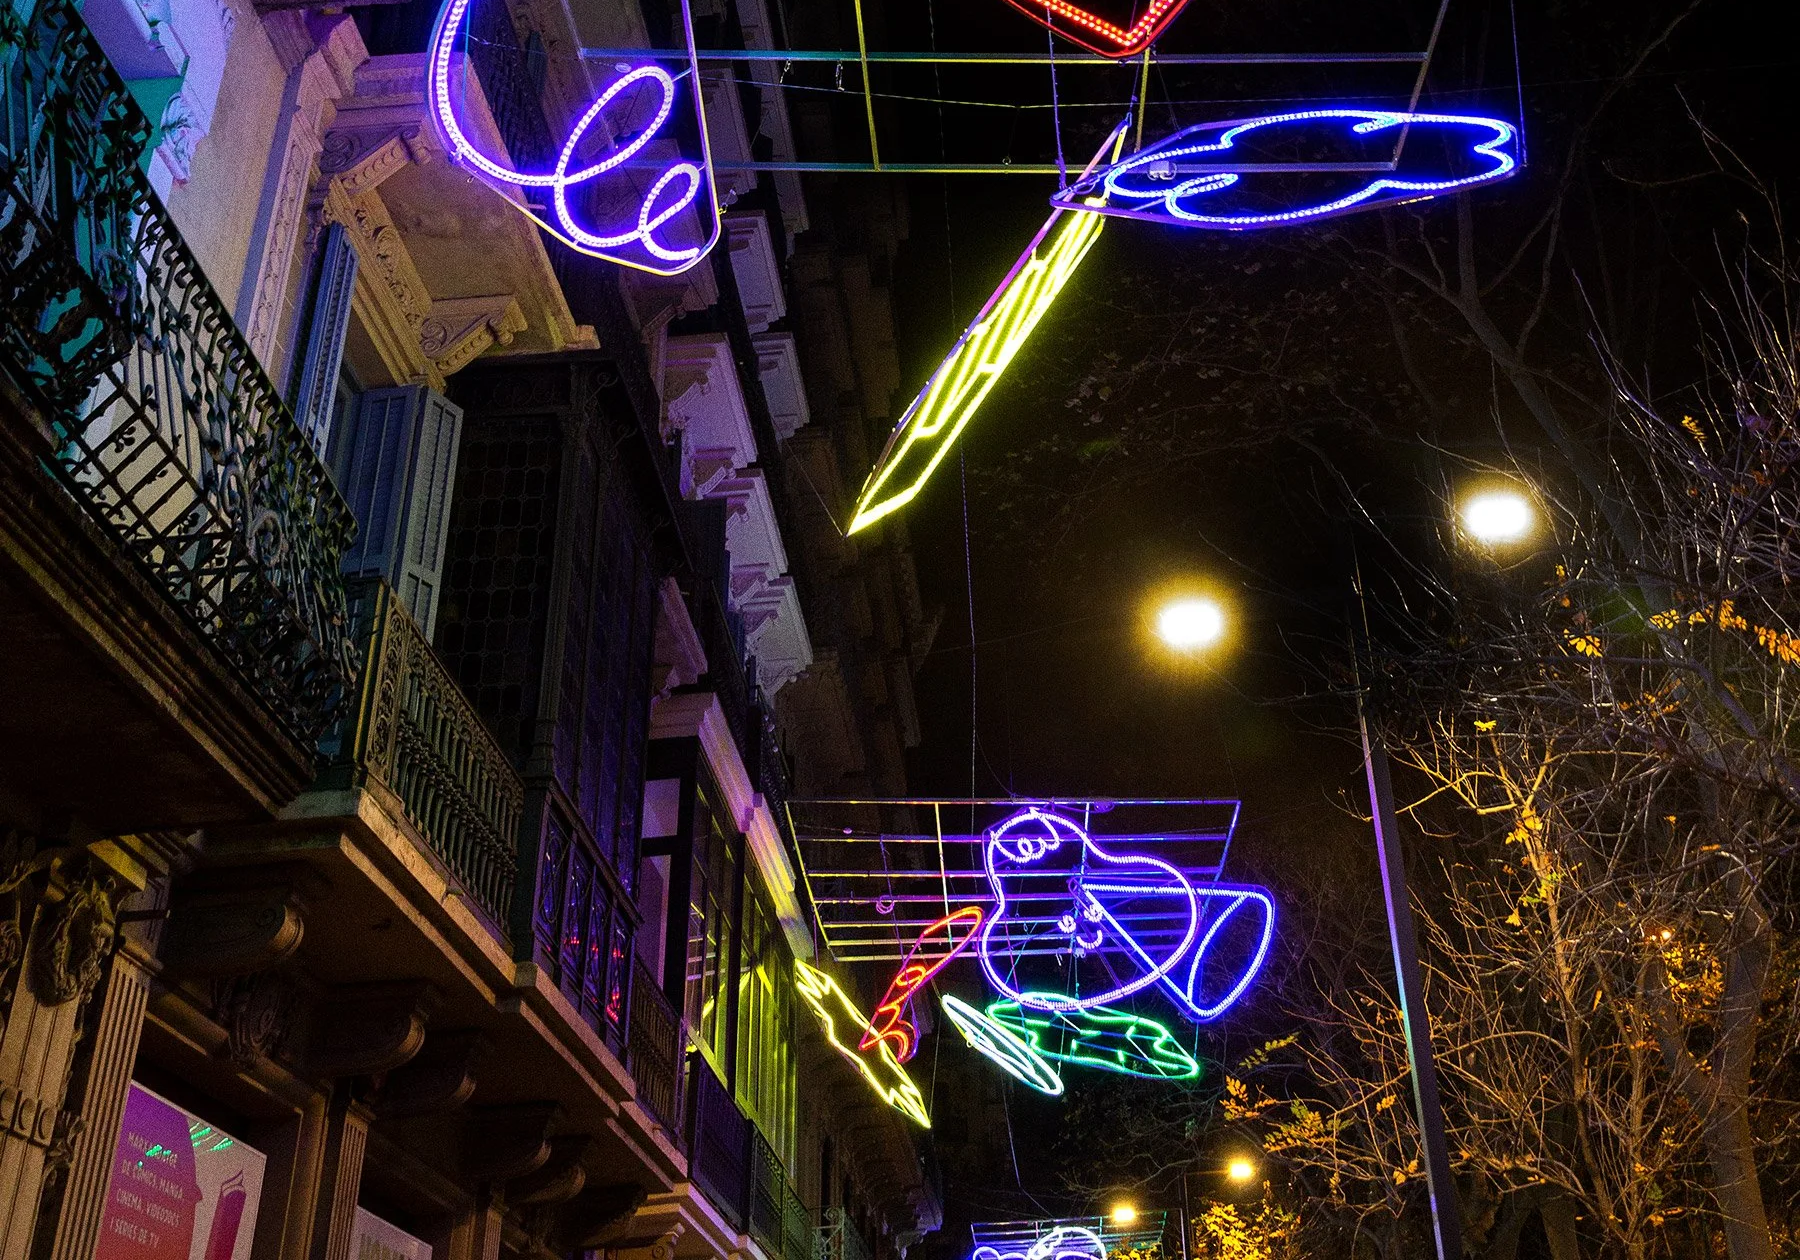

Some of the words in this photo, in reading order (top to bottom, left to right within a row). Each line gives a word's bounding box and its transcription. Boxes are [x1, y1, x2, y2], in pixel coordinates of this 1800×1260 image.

[121, 1159, 132, 1176] DE
[137, 1227, 148, 1244] DE
[149, 1232, 160, 1248] TV
